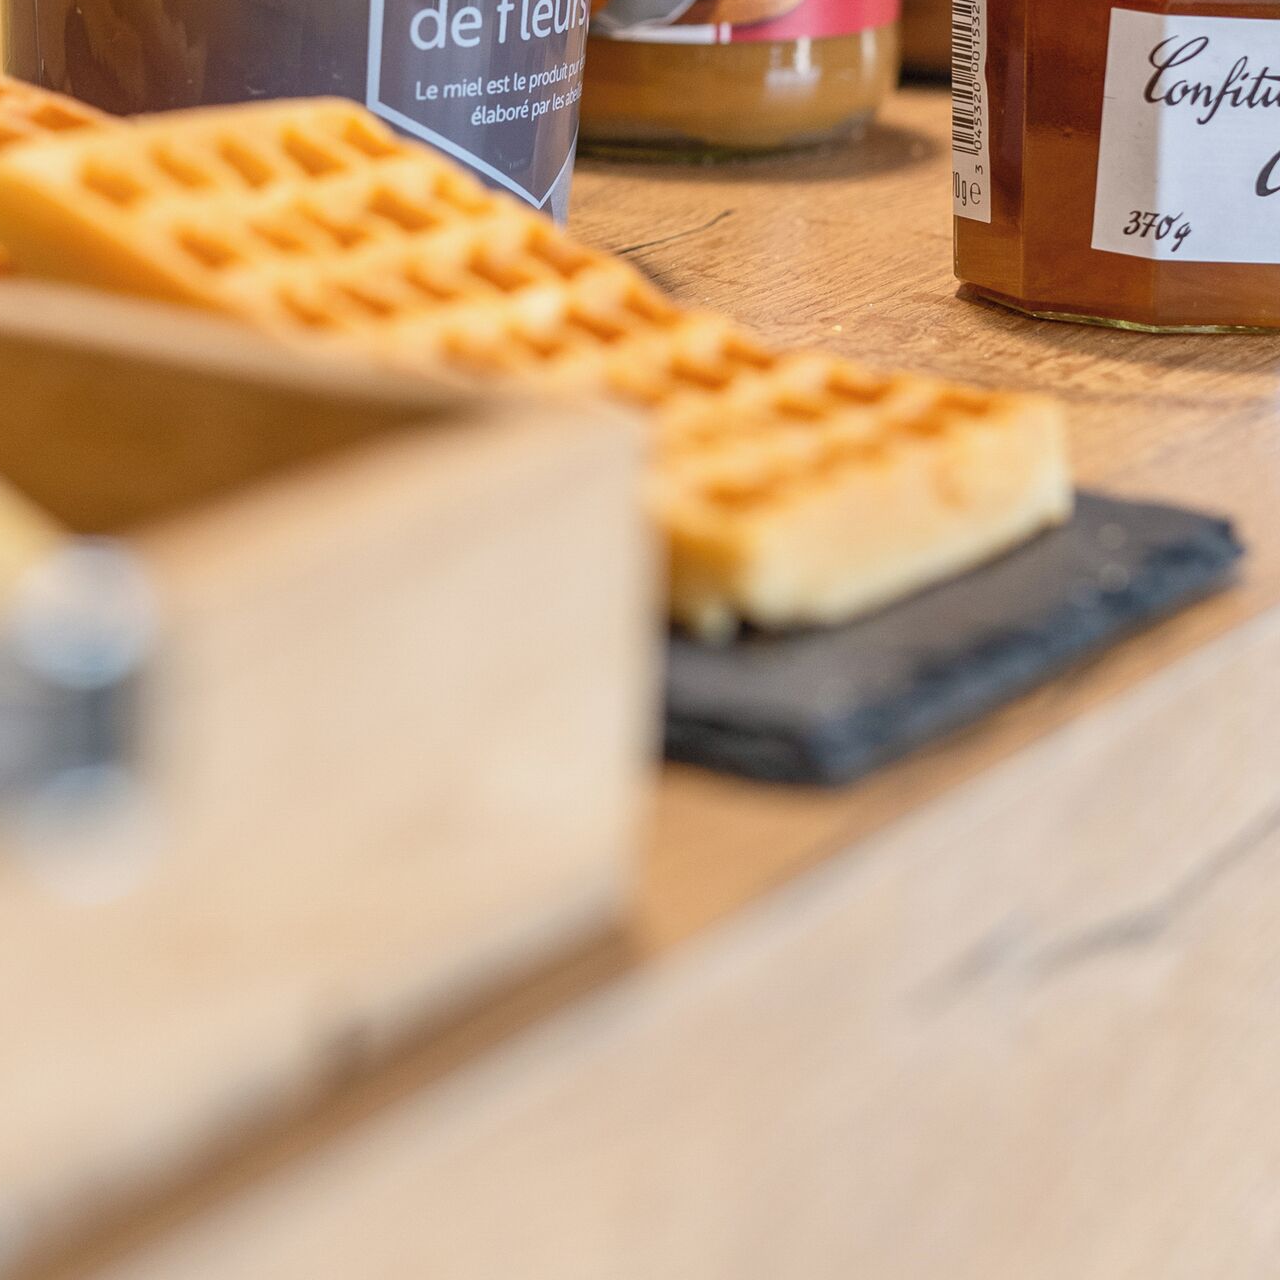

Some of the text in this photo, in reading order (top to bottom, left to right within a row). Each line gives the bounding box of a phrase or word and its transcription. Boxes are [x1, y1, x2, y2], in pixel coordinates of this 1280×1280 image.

[415, 80, 439, 101] Le
[442, 76, 483, 99] miel
[486, 73, 510, 95] est
[513, 72, 526, 91] le
[528, 62, 568, 94] produit
[971, 4, 983, 175] 3 045320 001532
[471, 98, 529, 125] élaboré
[531, 97, 551, 121] par
[552, 92, 565, 112] les
